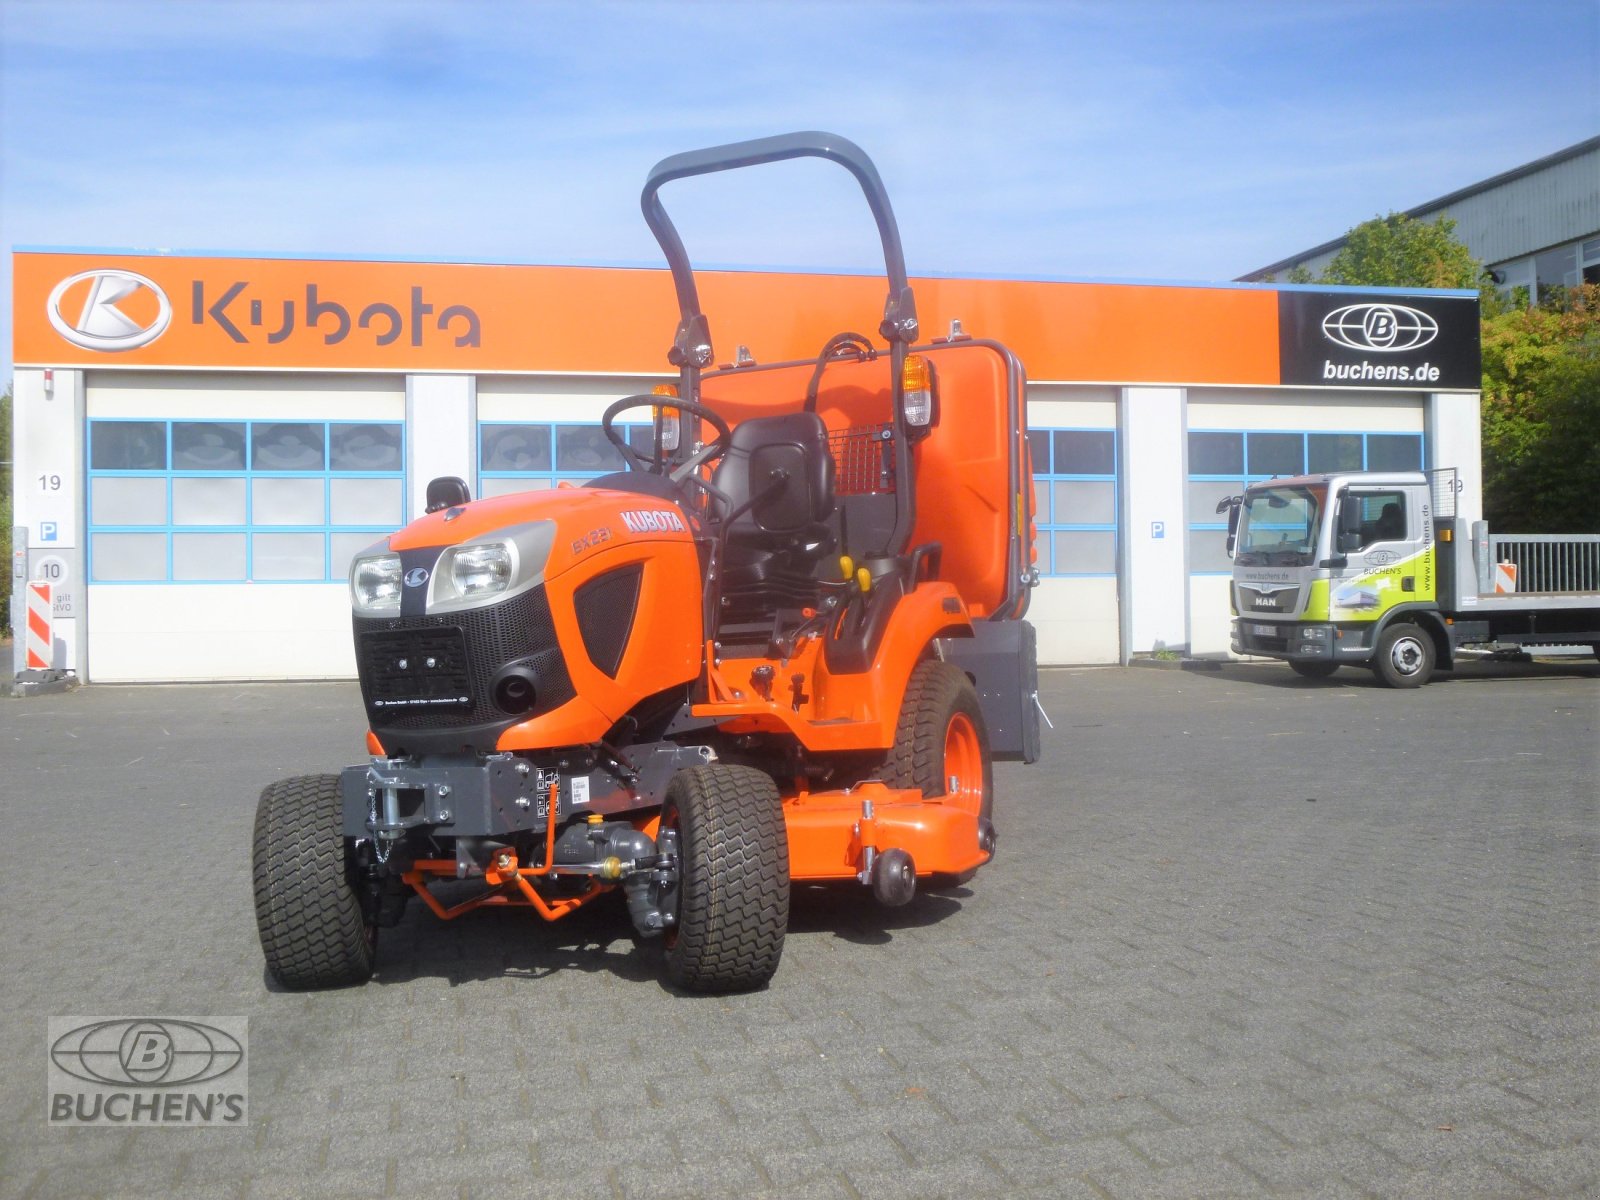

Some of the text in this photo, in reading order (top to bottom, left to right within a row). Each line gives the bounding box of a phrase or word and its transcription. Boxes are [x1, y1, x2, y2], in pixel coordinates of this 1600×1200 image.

[192, 280, 481, 348] Kubota
[1323, 360, 1440, 381] buchens.de
[38, 474, 61, 491] 19
[620, 510, 687, 533] KUBOTA
[42, 523, 56, 540] P
[1422, 504, 1431, 591] www.buchens.de
[43, 563, 60, 578] 10
[56, 593, 71, 603] gilt
[1255, 598, 1276, 606] MAN
